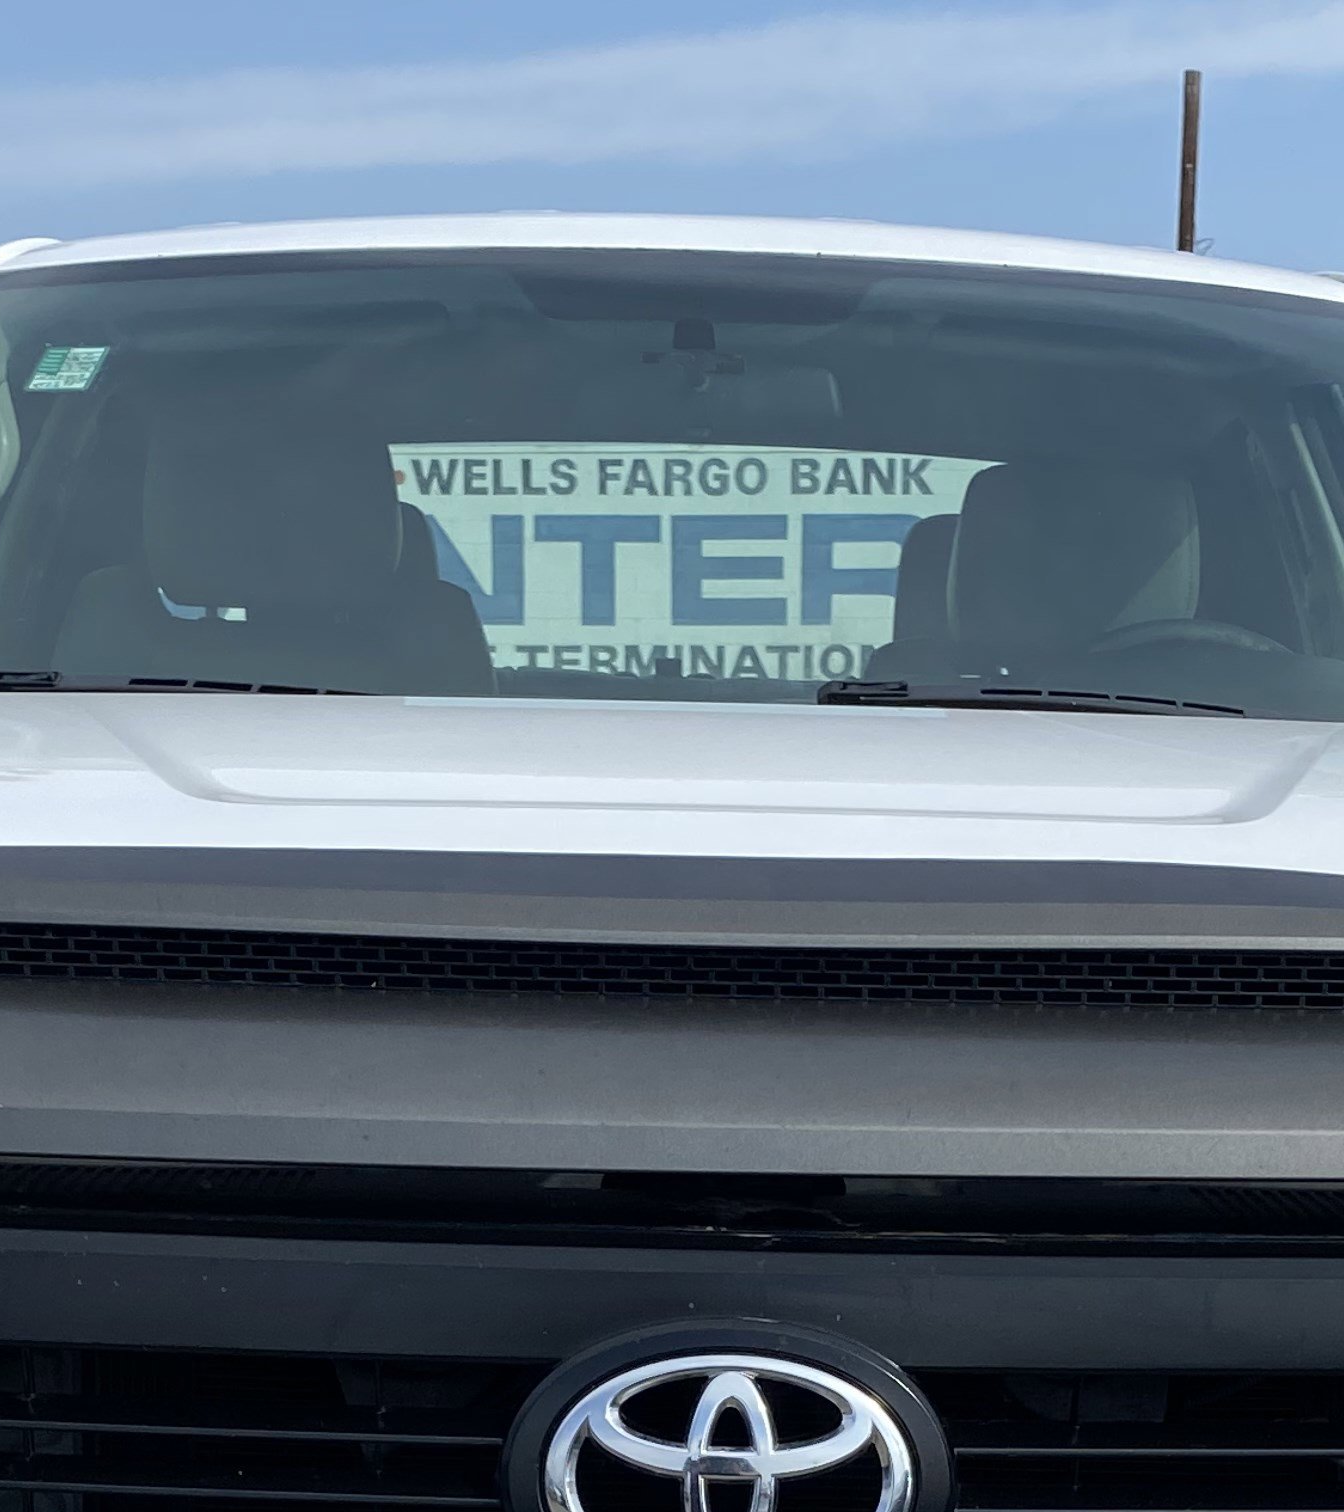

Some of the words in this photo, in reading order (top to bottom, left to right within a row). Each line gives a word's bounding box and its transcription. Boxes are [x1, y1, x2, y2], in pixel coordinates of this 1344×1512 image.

[411, 458, 578, 495] WELLS
[597, 458, 769, 496] FARGO
[790, 458, 935, 495] BANK
